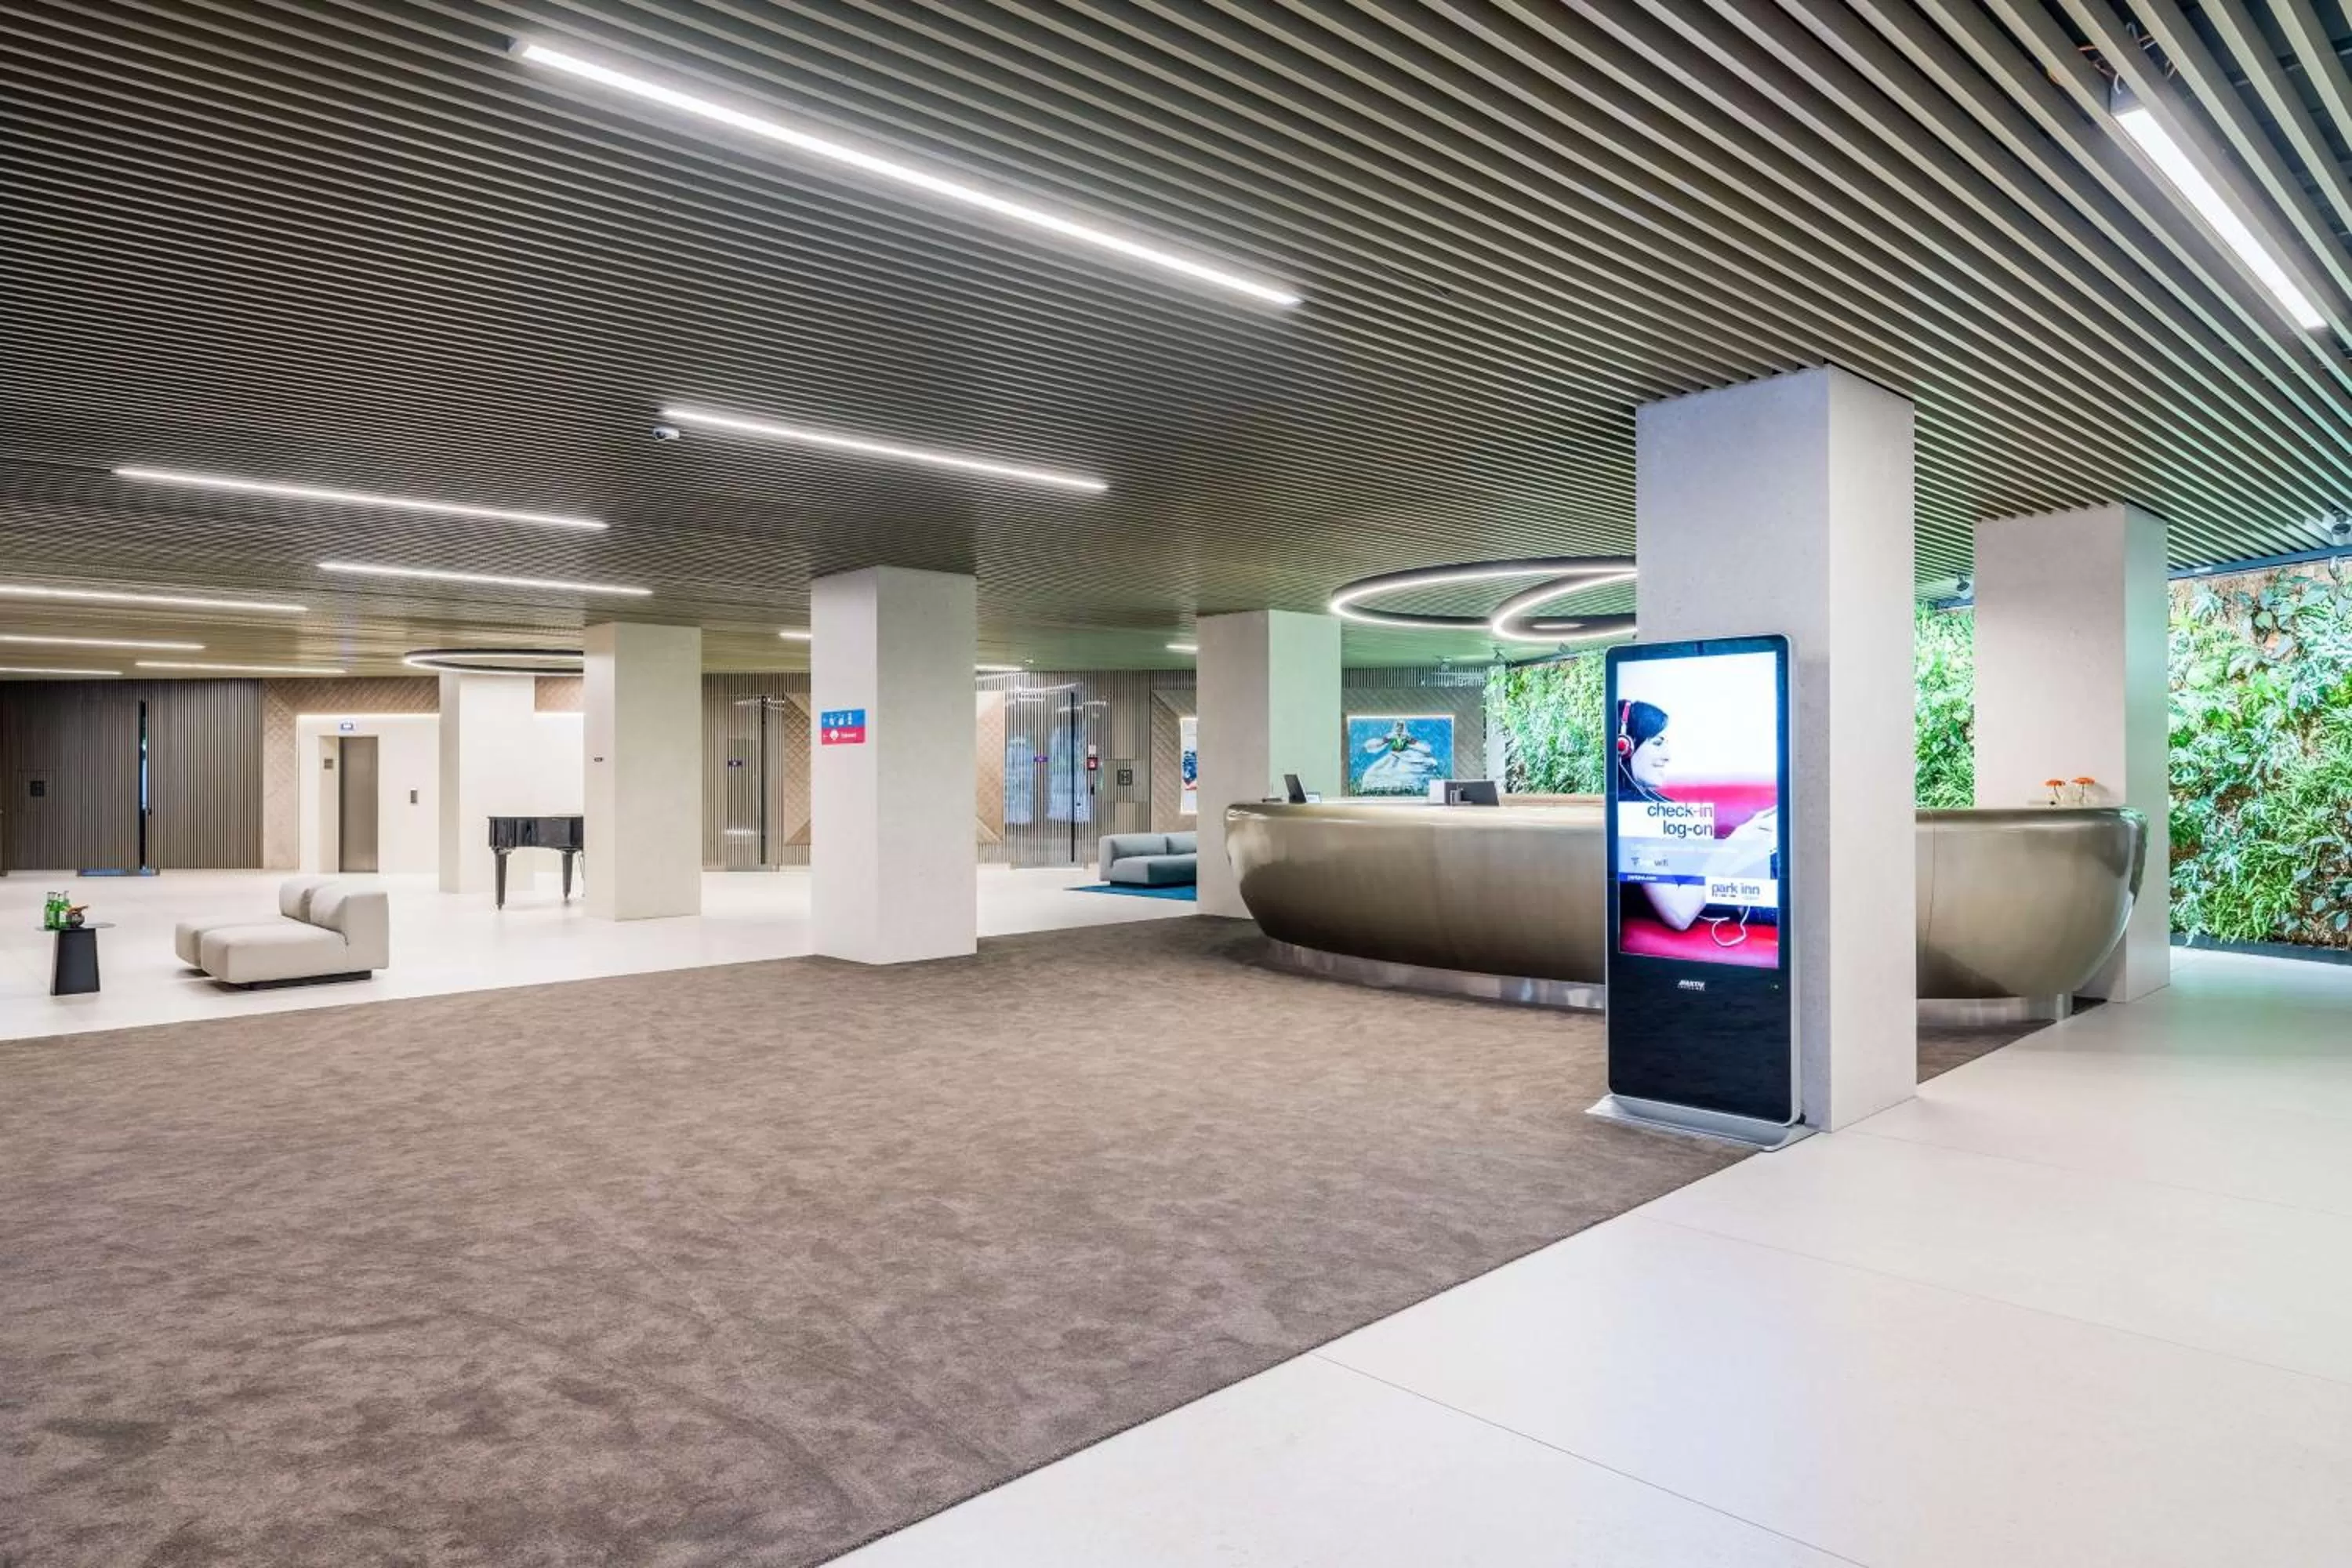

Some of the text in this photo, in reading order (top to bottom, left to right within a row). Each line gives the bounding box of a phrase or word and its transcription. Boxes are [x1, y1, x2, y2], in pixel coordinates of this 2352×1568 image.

[1647, 802, 1713, 818] check-in
[1663, 819, 1713, 839] log-on
[1711, 882, 1760, 897] park inn
